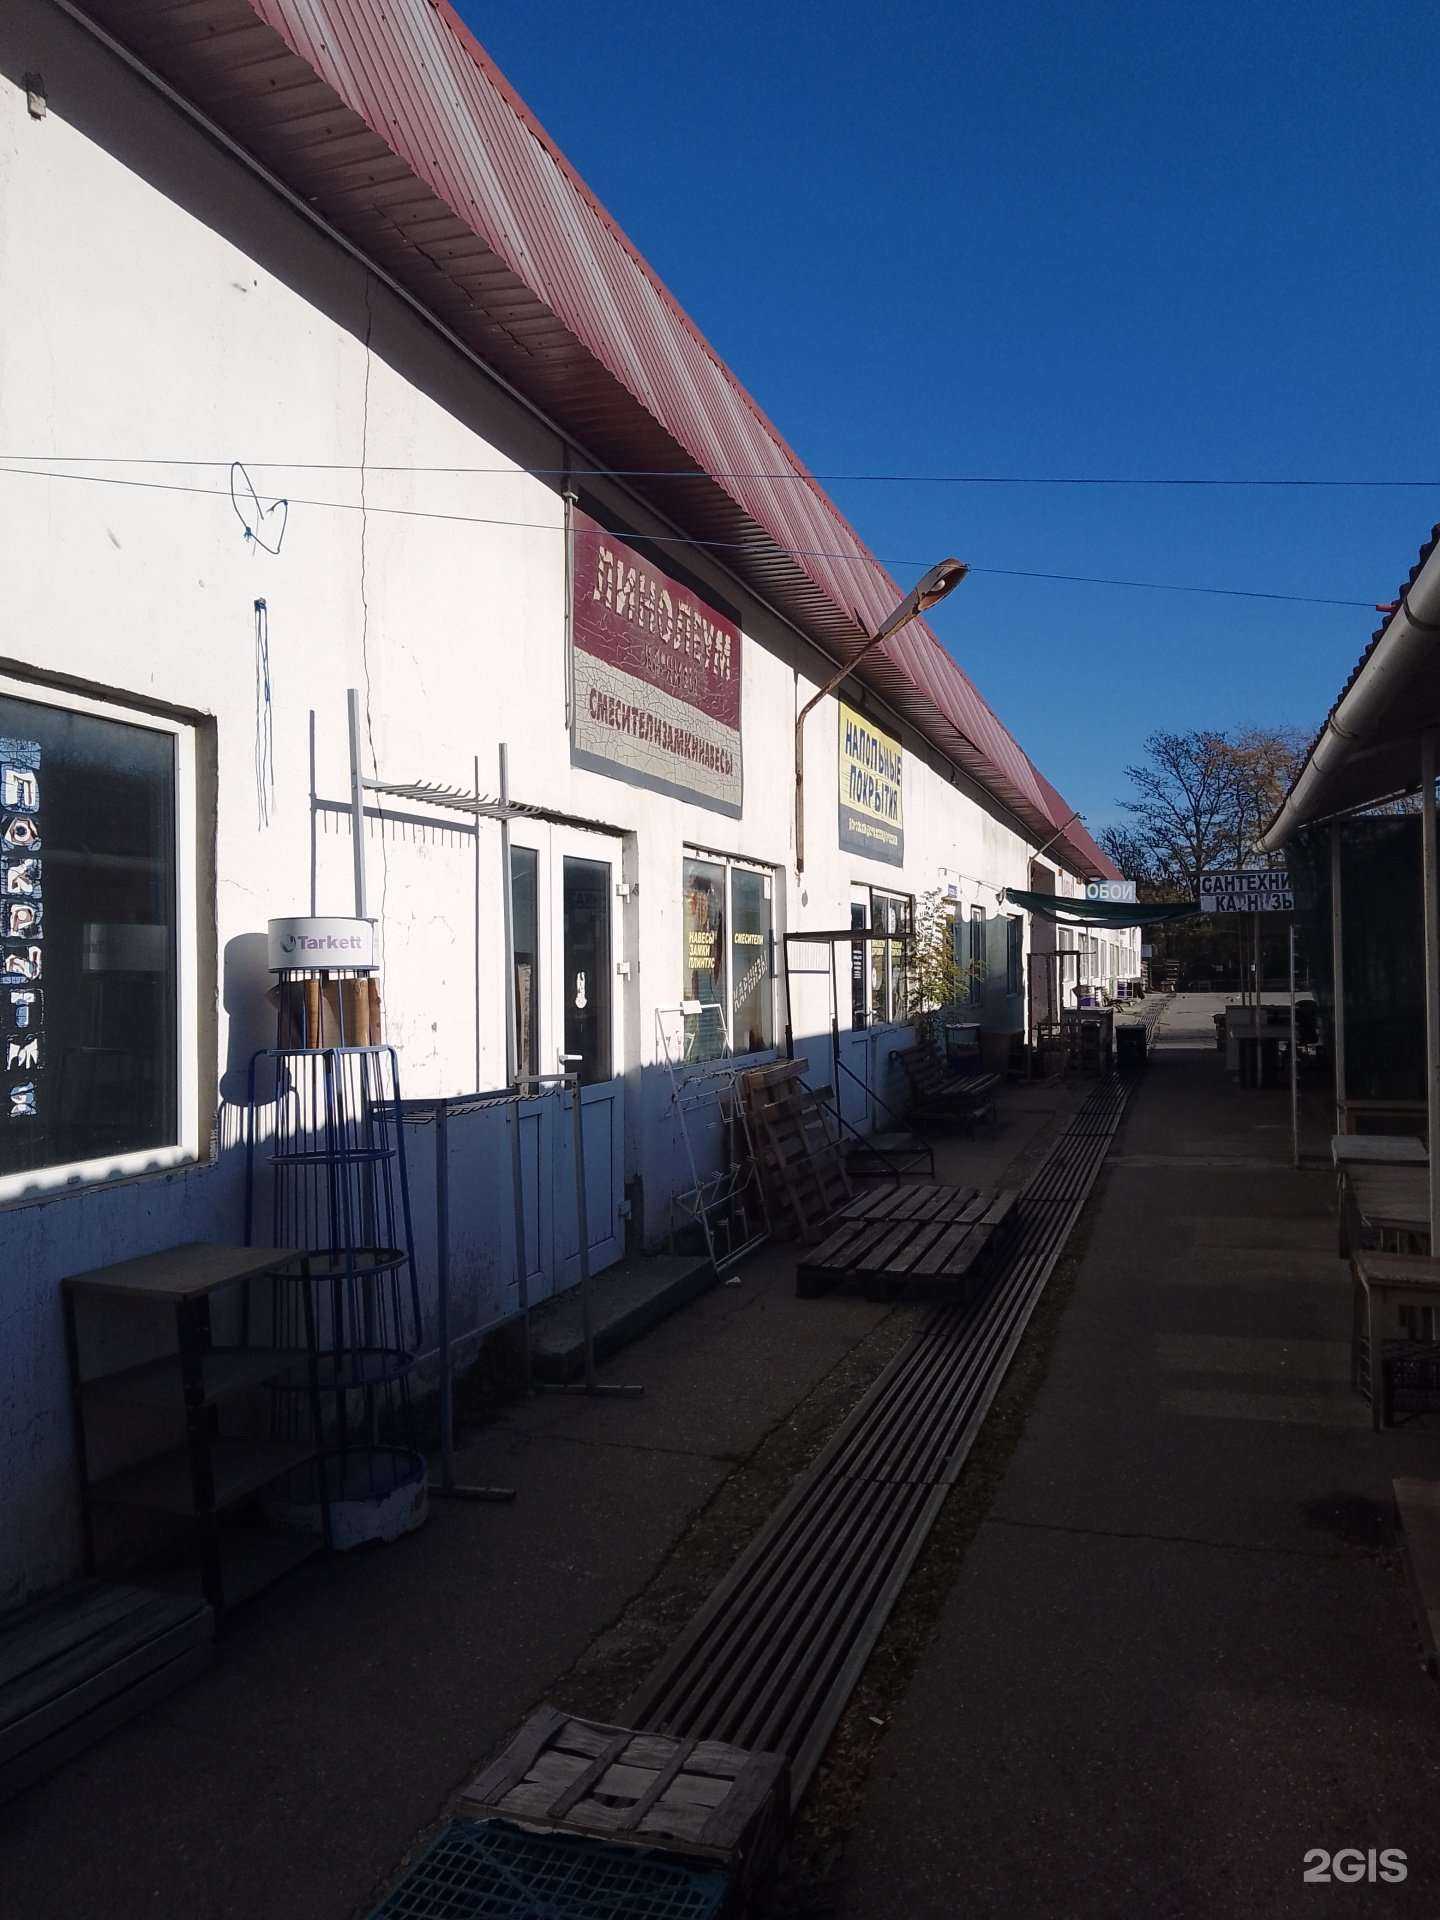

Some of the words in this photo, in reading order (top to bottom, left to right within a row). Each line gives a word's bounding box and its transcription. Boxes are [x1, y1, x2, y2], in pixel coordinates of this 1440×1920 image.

[593, 545, 731, 681] ЛИНОЛЕУМ
[845, 719, 902, 786] НАПОЛЬНЫЕ
[849, 765, 898, 820] ПОКРЫТИЯ
[1087, 884, 1133, 899] ОБОИ
[297, 936, 362, 950] Tarkett
[689, 931, 715, 944] НАВЕСЫ
[734, 933, 764, 945] СМЕСИТЕЛИ
